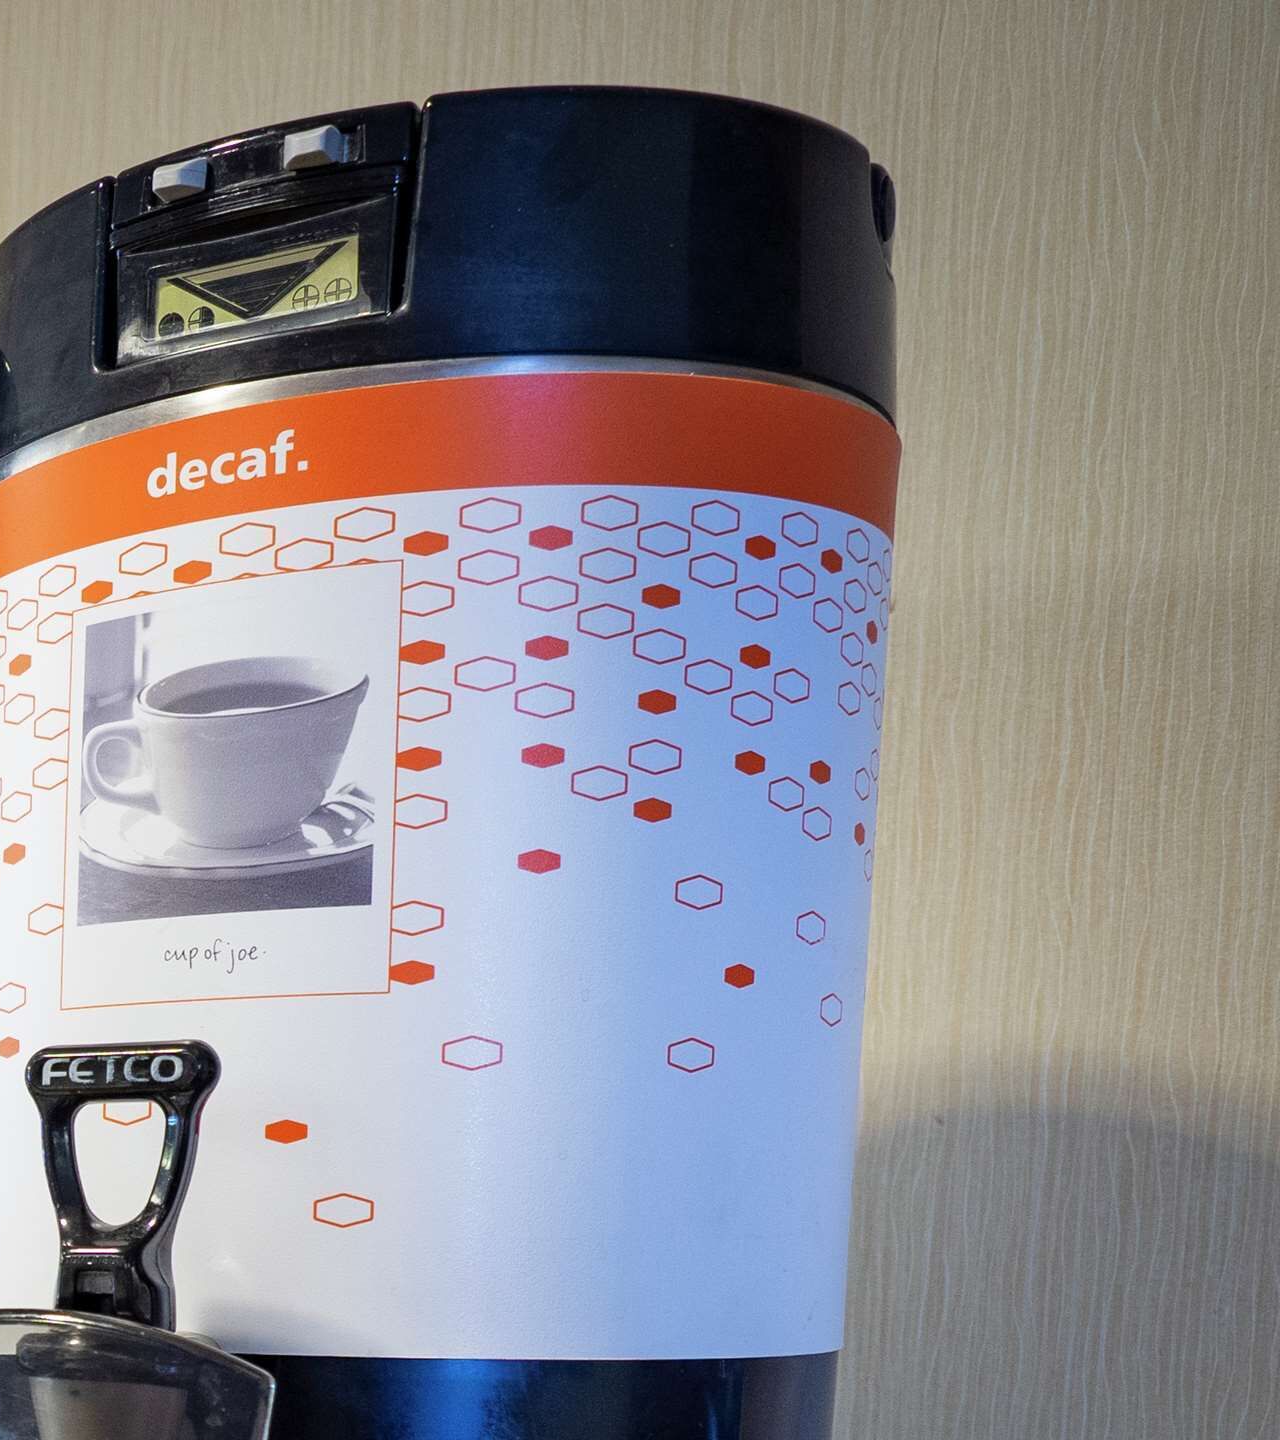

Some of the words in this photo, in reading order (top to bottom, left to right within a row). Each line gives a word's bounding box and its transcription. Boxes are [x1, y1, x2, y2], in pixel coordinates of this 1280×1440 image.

[146, 428, 309, 498] decaf.
[164, 947, 198, 969] cup
[204, 938, 222, 961] of
[41, 1054, 184, 1086] FETCO
